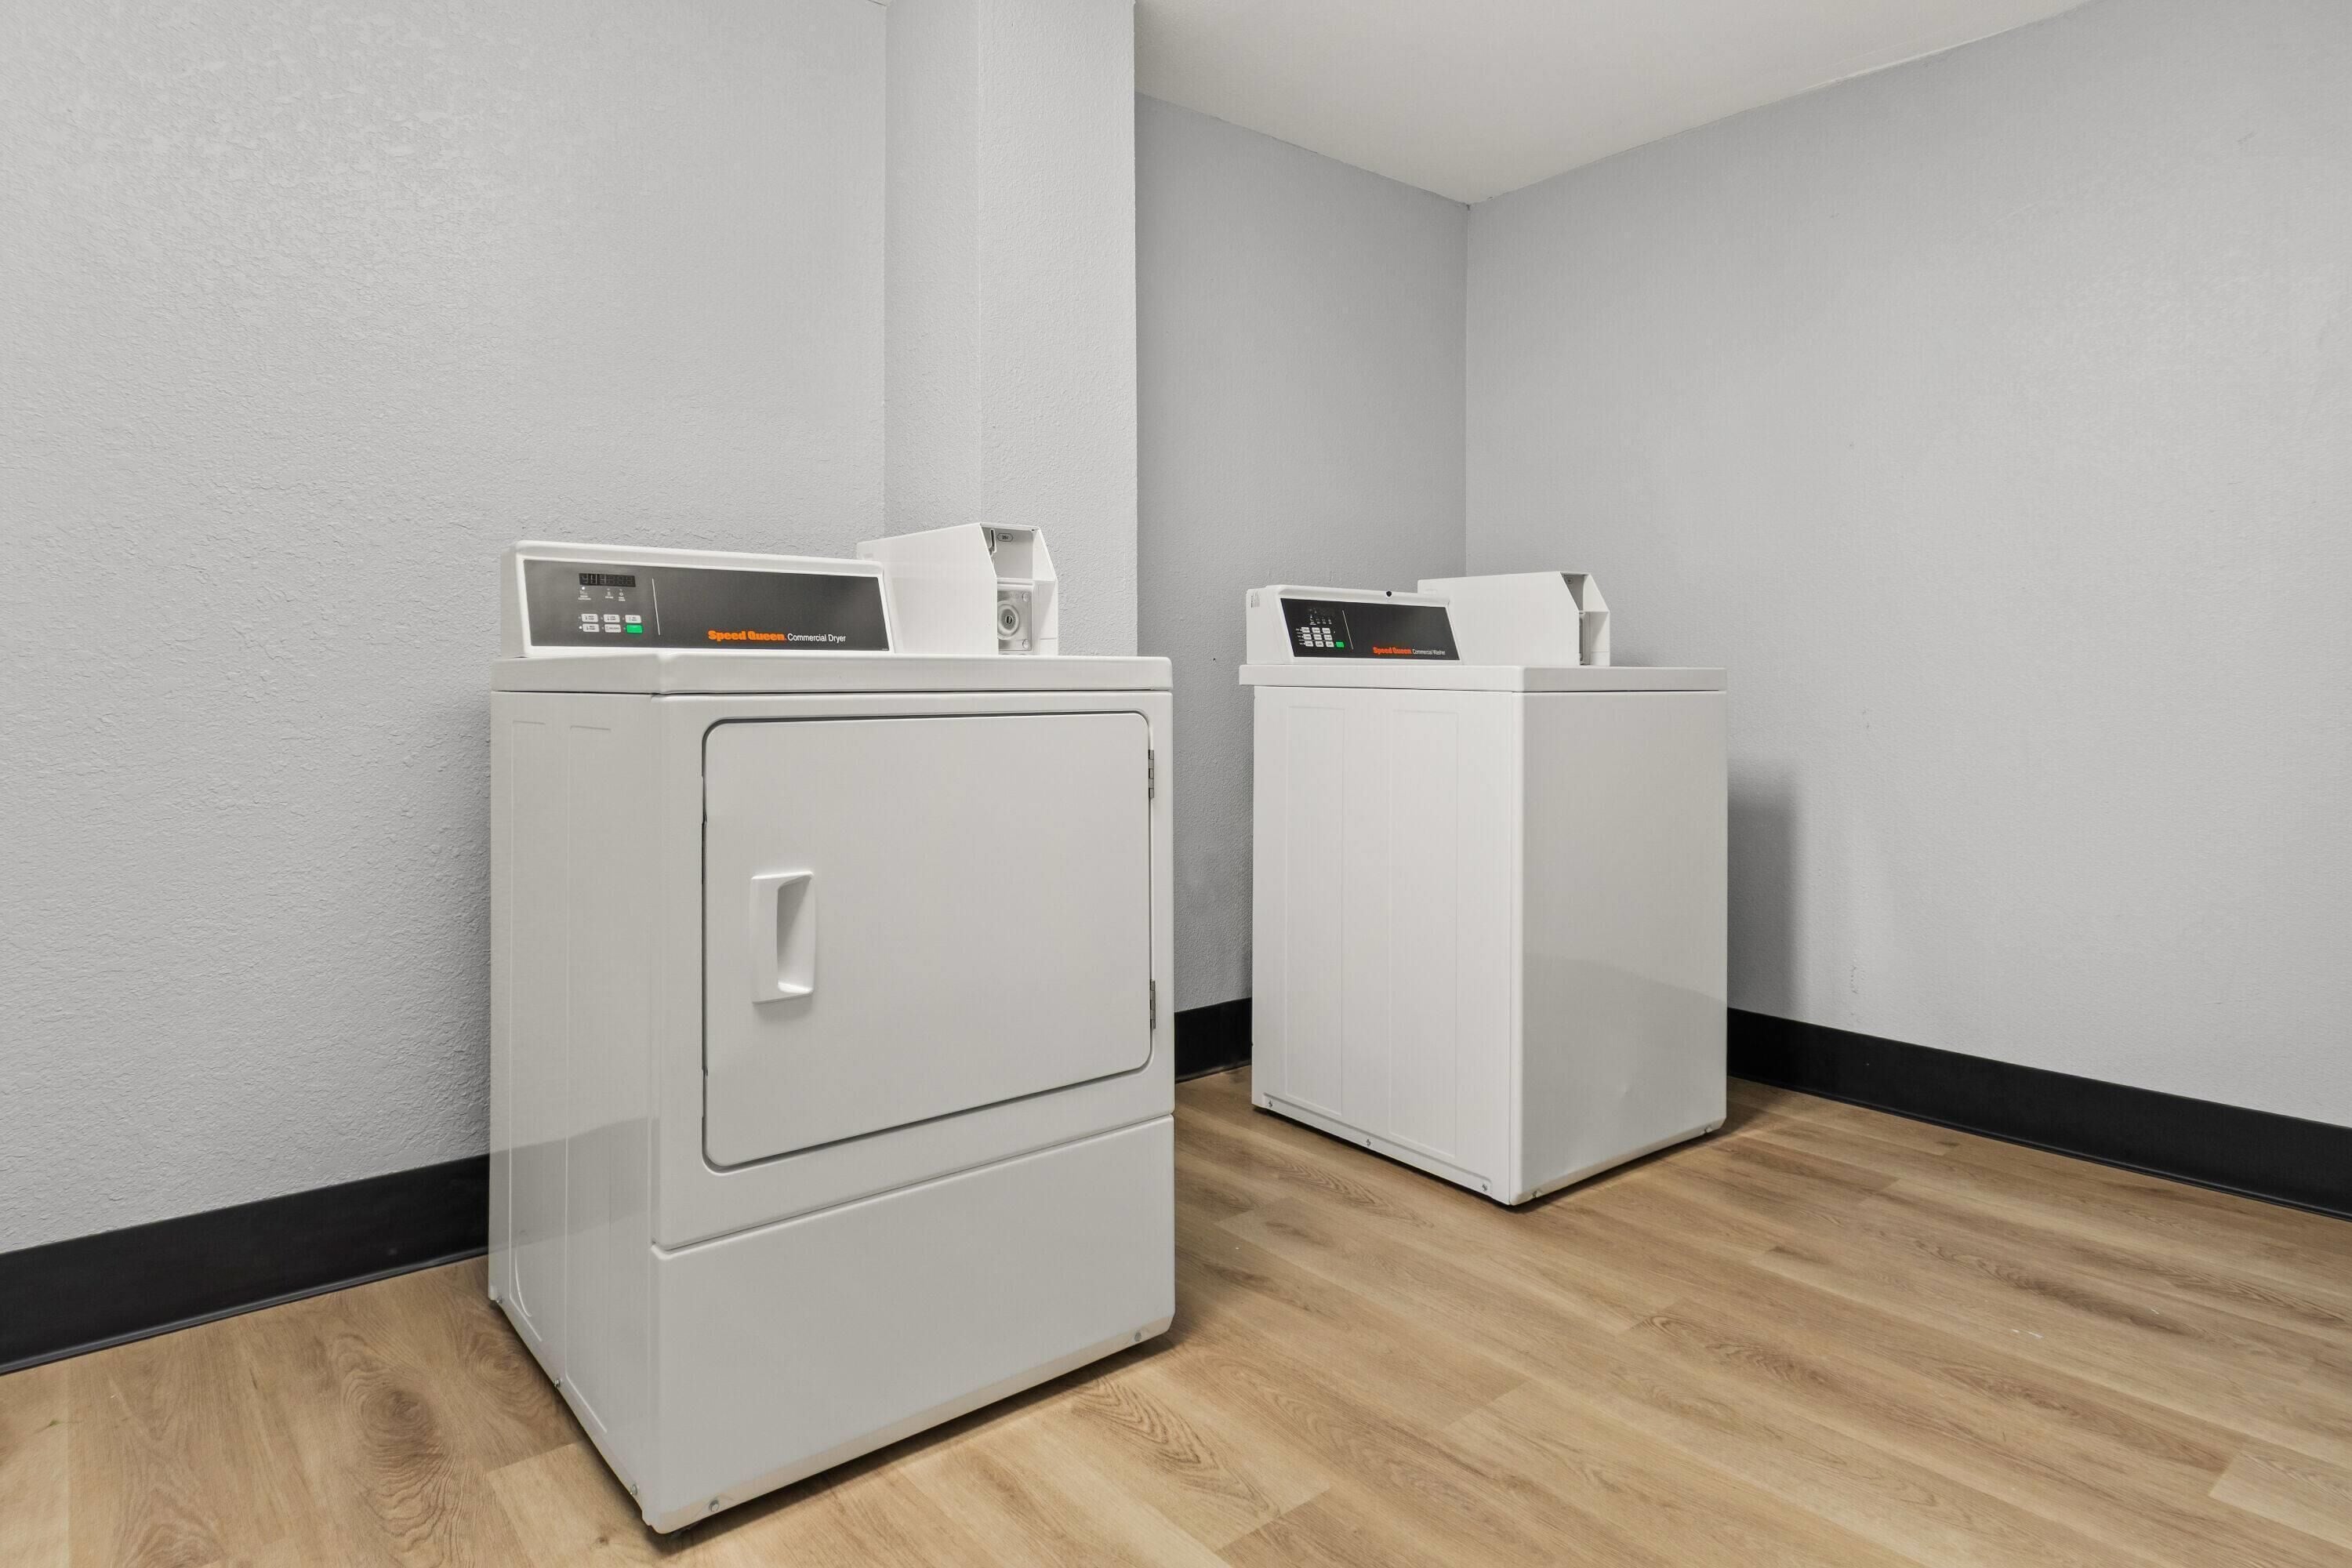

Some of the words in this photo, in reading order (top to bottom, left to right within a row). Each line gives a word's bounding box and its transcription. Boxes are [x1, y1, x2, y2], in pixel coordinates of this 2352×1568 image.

[708, 630, 746, 641] Speed
[747, 630, 786, 641] Queen
[787, 633, 826, 642] Commercial
[828, 633, 847, 643] Dryer
[1373, 647, 1392, 655] Speed
